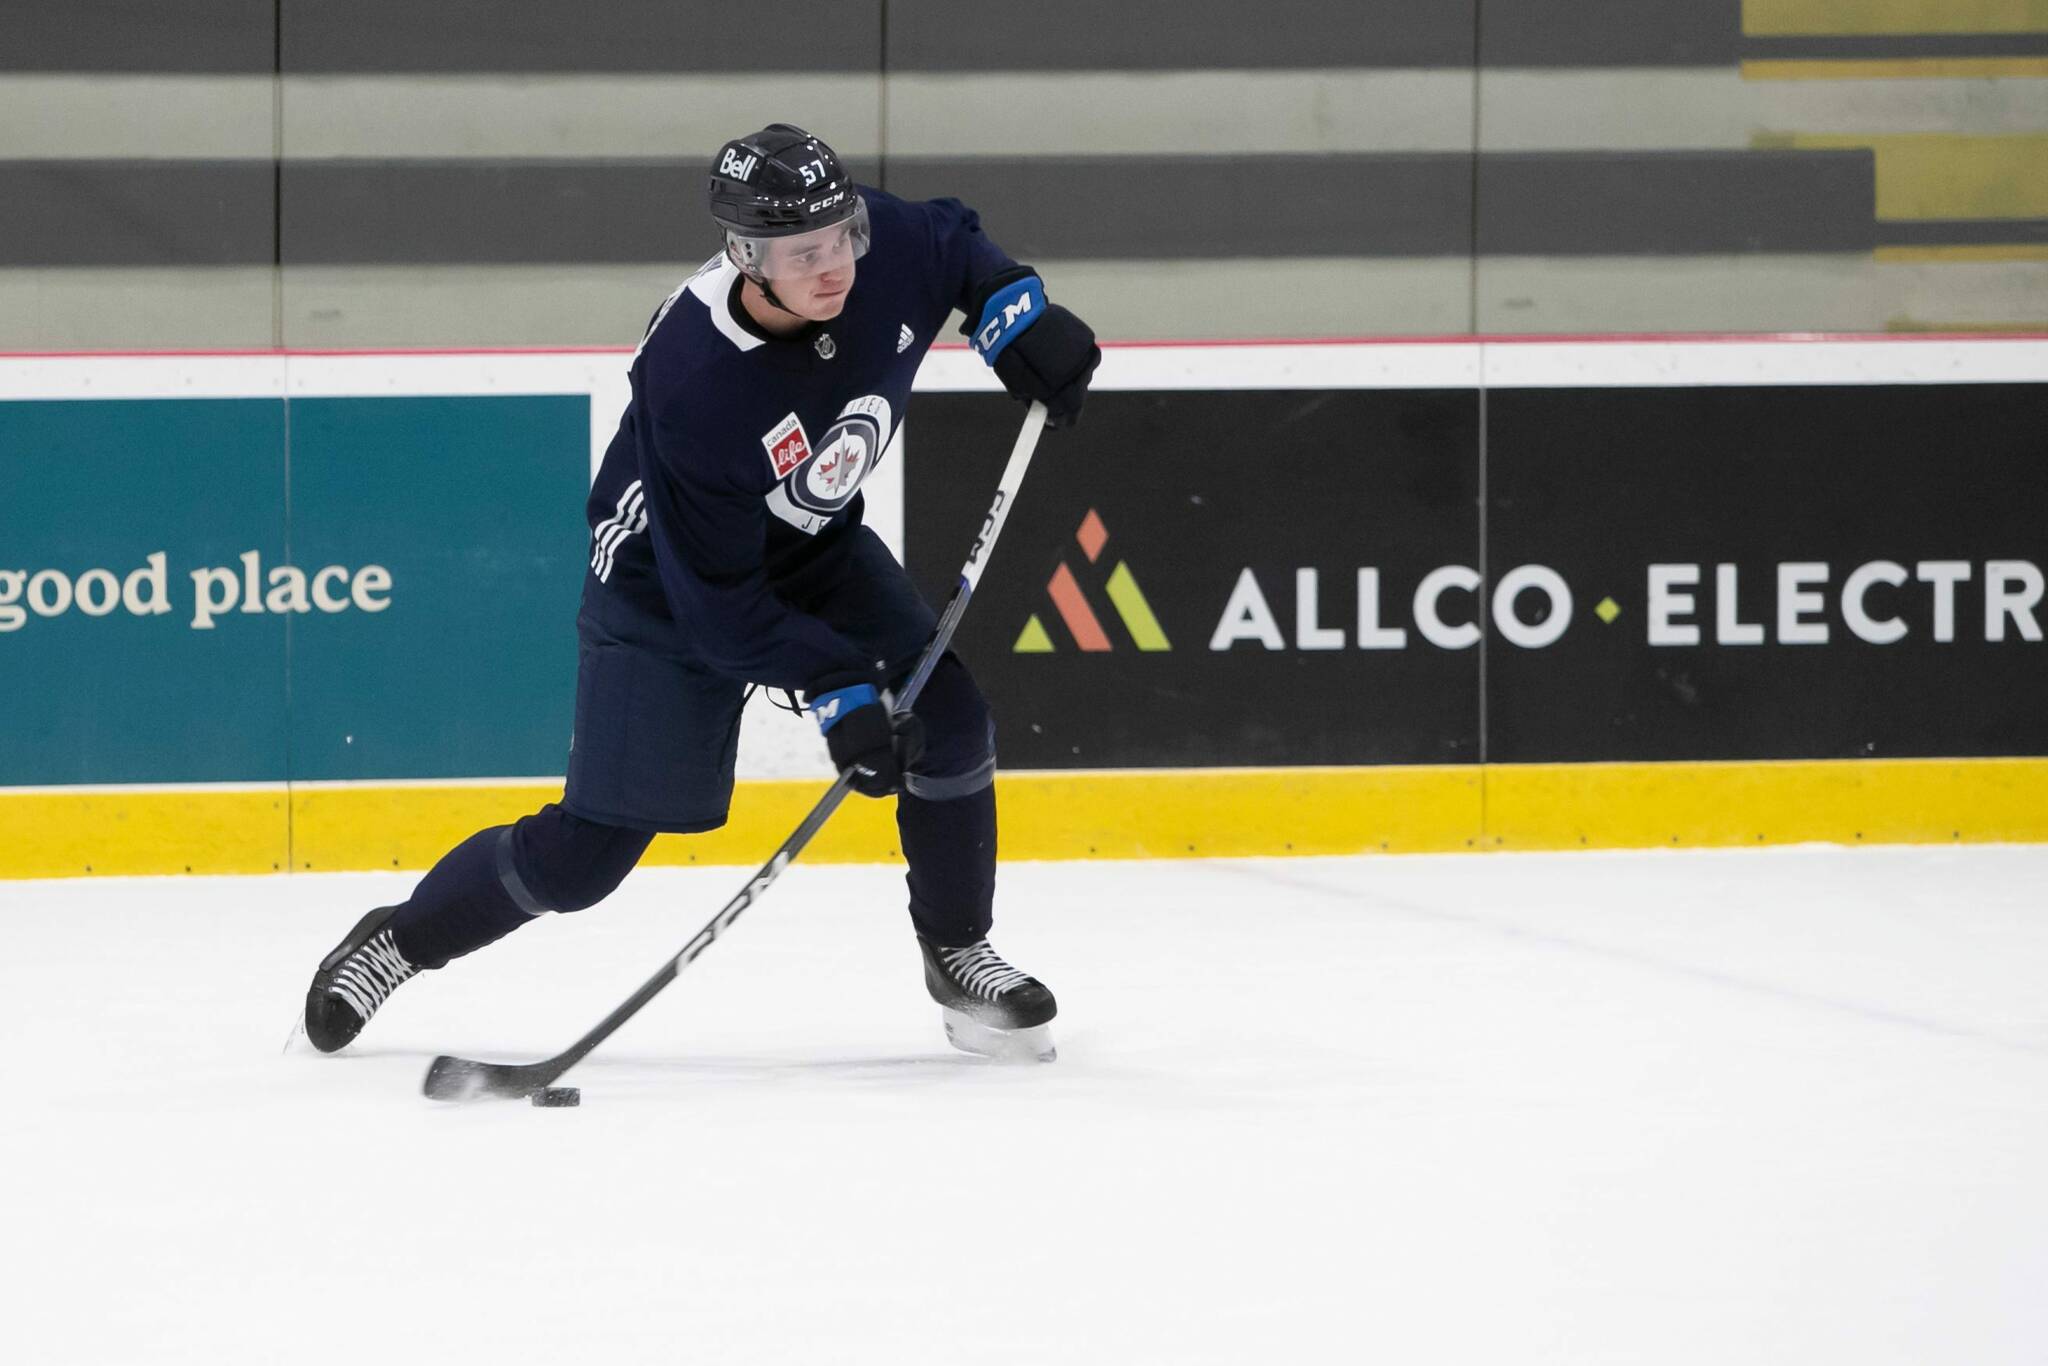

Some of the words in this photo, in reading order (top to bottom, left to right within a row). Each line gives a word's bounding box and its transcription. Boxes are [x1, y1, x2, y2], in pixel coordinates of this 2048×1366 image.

[719, 148, 757, 182] Bell
[799, 159, 826, 187] 57
[809, 191, 845, 213] CCM
[974, 291, 1032, 353] CM
[766, 418, 798, 447] canada
[777, 440, 807, 468] life
[801, 516, 828, 531] JE
[190, 549, 393, 629] place
[1209, 564, 1573, 650] ALLCO
[1648, 560, 2045, 646] ELECTR
